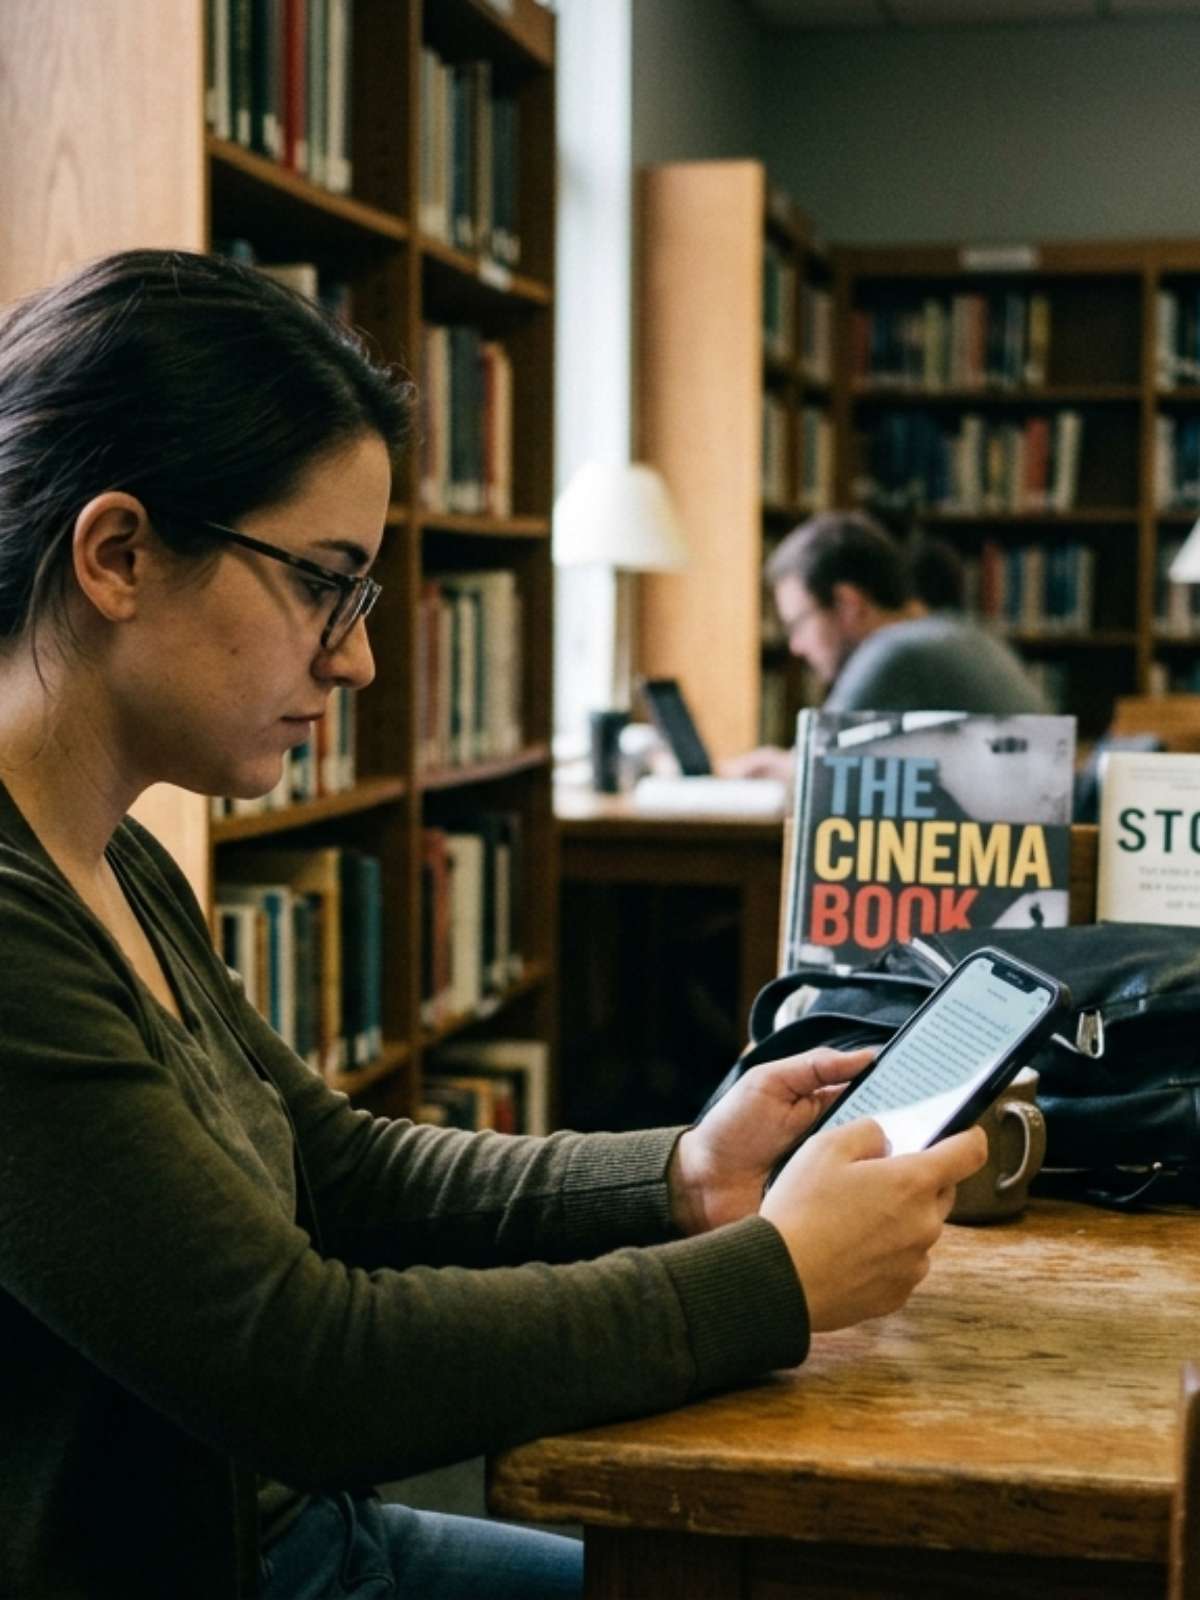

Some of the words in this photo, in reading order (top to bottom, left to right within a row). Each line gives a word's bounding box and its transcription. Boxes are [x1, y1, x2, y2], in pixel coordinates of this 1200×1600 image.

[823, 756, 938, 818] THE
[814, 818, 1053, 889] CINEMA
[810, 883, 979, 951] BOOK
